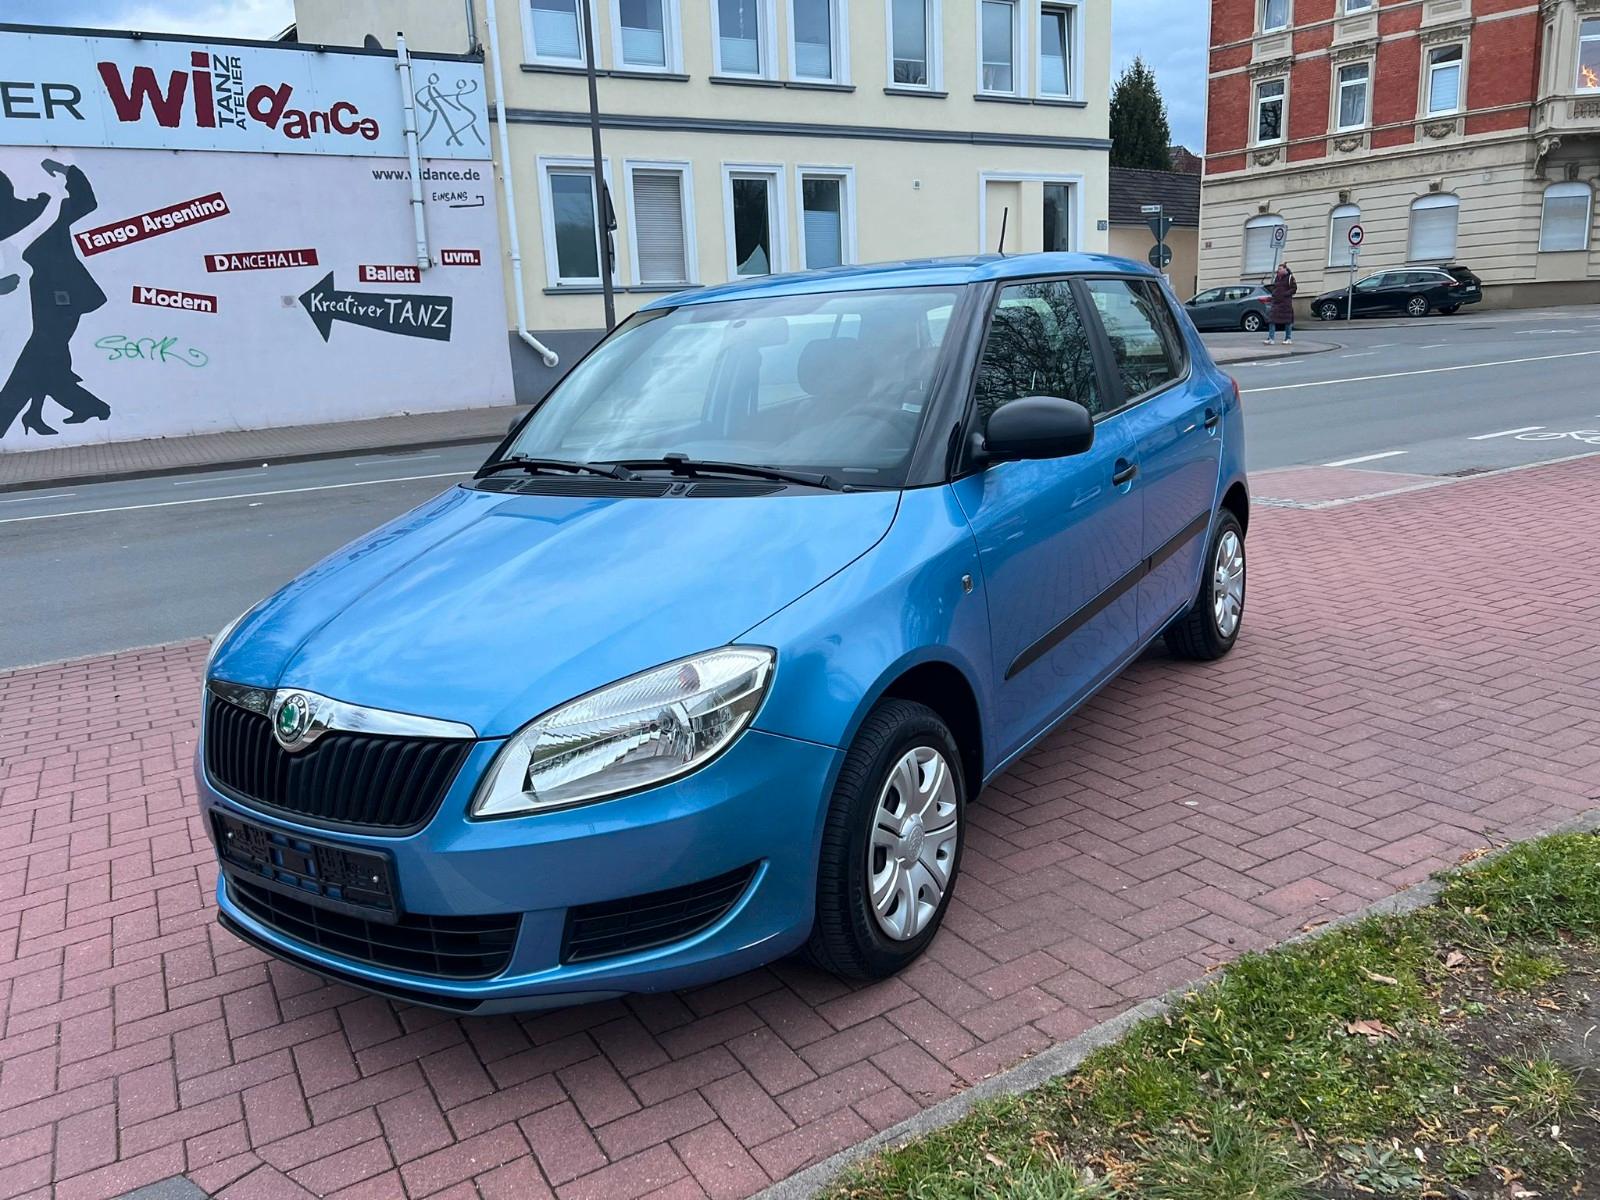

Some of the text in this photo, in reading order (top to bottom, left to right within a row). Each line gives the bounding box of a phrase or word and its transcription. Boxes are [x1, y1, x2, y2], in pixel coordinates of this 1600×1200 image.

[213, 53, 232, 128] TANZ
[230, 56, 248, 130] ATELIER
[372, 168, 481, 181] www.idance.de
[80, 197, 226, 250] Tango Argentino
[444, 252, 479, 264] uvm.
[365, 265, 416, 282] Ballett
[140, 287, 212, 312] Modern
[310, 293, 448, 328] Kreativer TANZ
